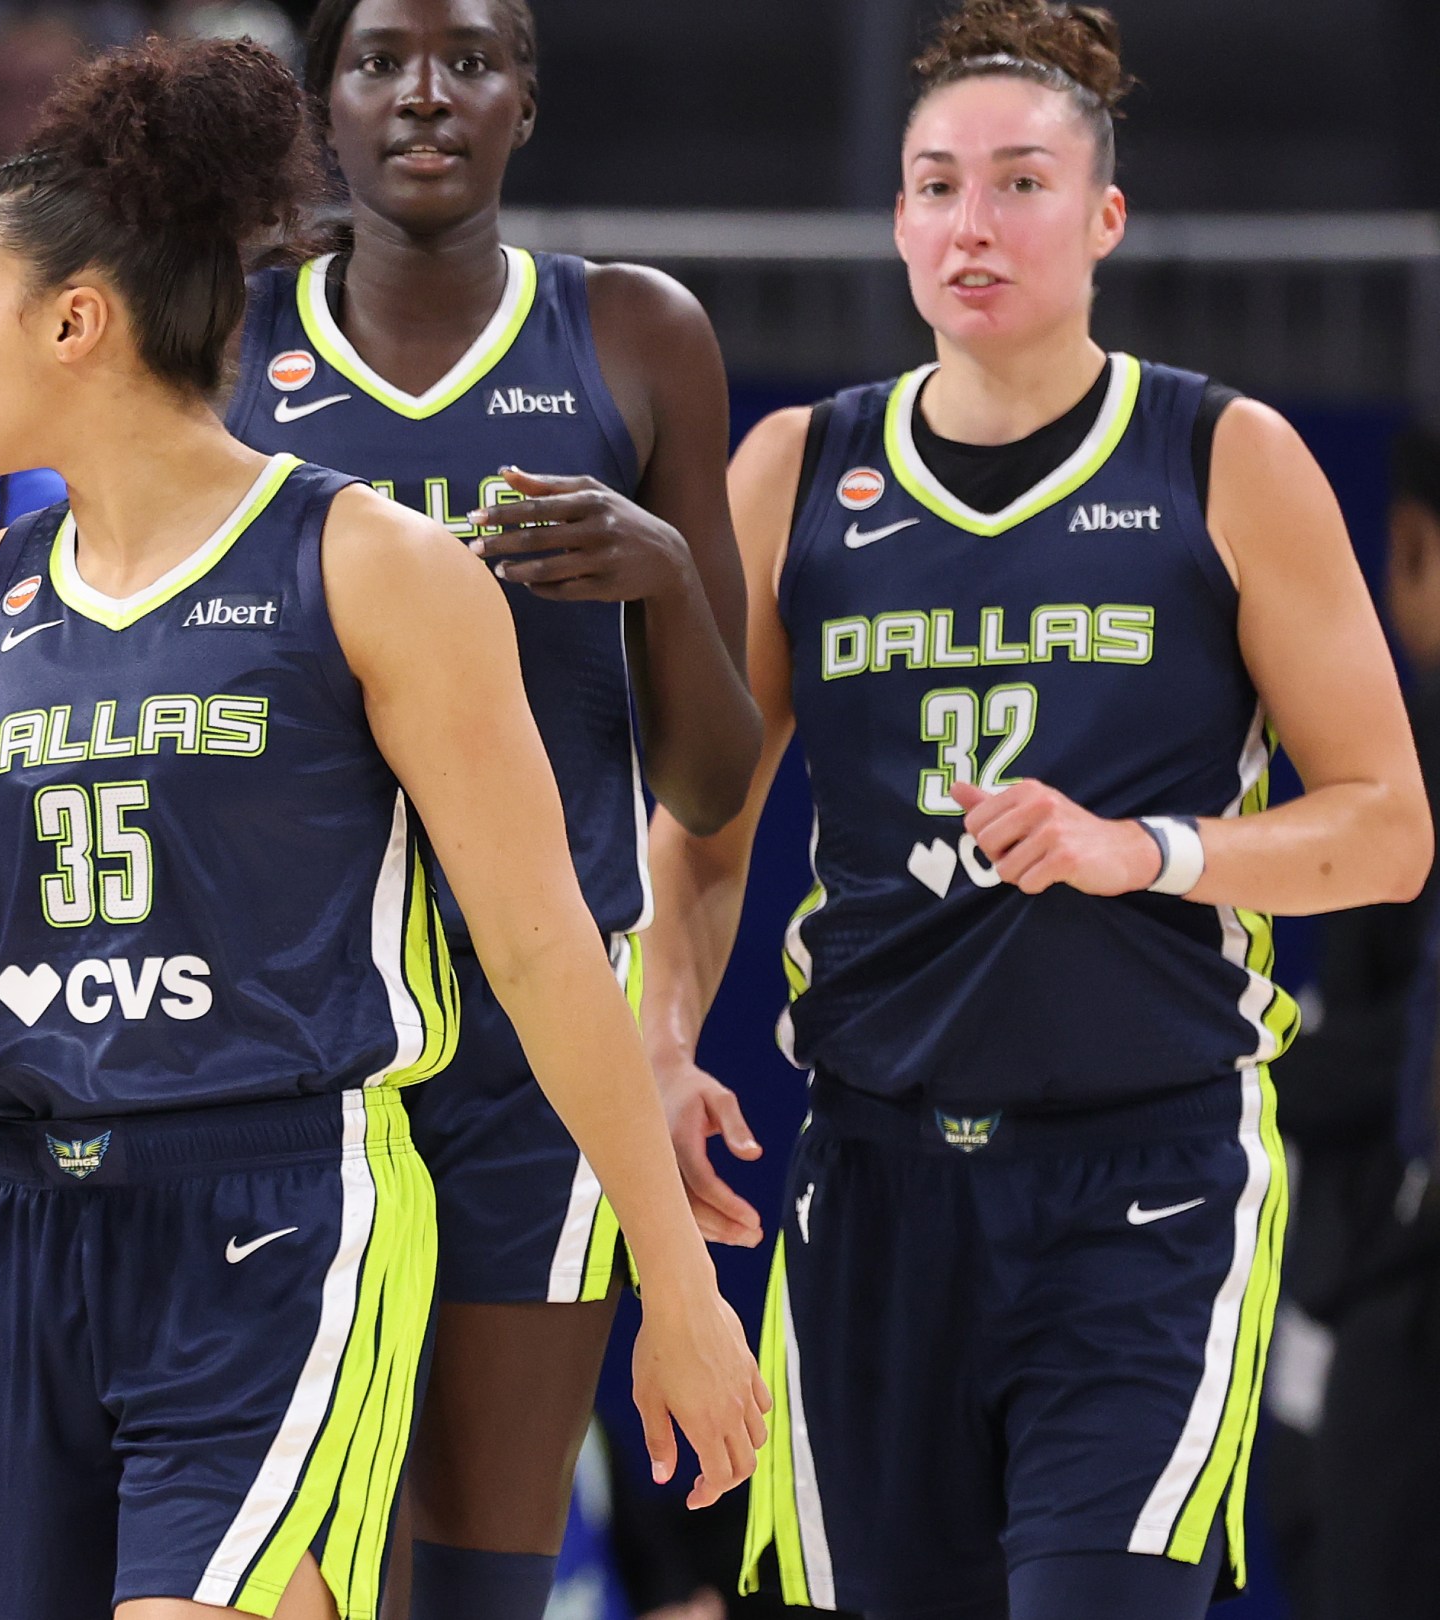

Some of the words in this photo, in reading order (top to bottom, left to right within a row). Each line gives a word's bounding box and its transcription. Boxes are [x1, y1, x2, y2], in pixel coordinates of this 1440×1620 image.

[486, 387, 577, 415] Albert
[1068, 503, 1161, 533] Albert
[181, 597, 277, 628] Albert
[821, 602, 1155, 681] DALLAS
[916, 681, 1039, 816] 32
[33, 779, 154, 929] 35
[65, 954, 213, 1025] CVS
